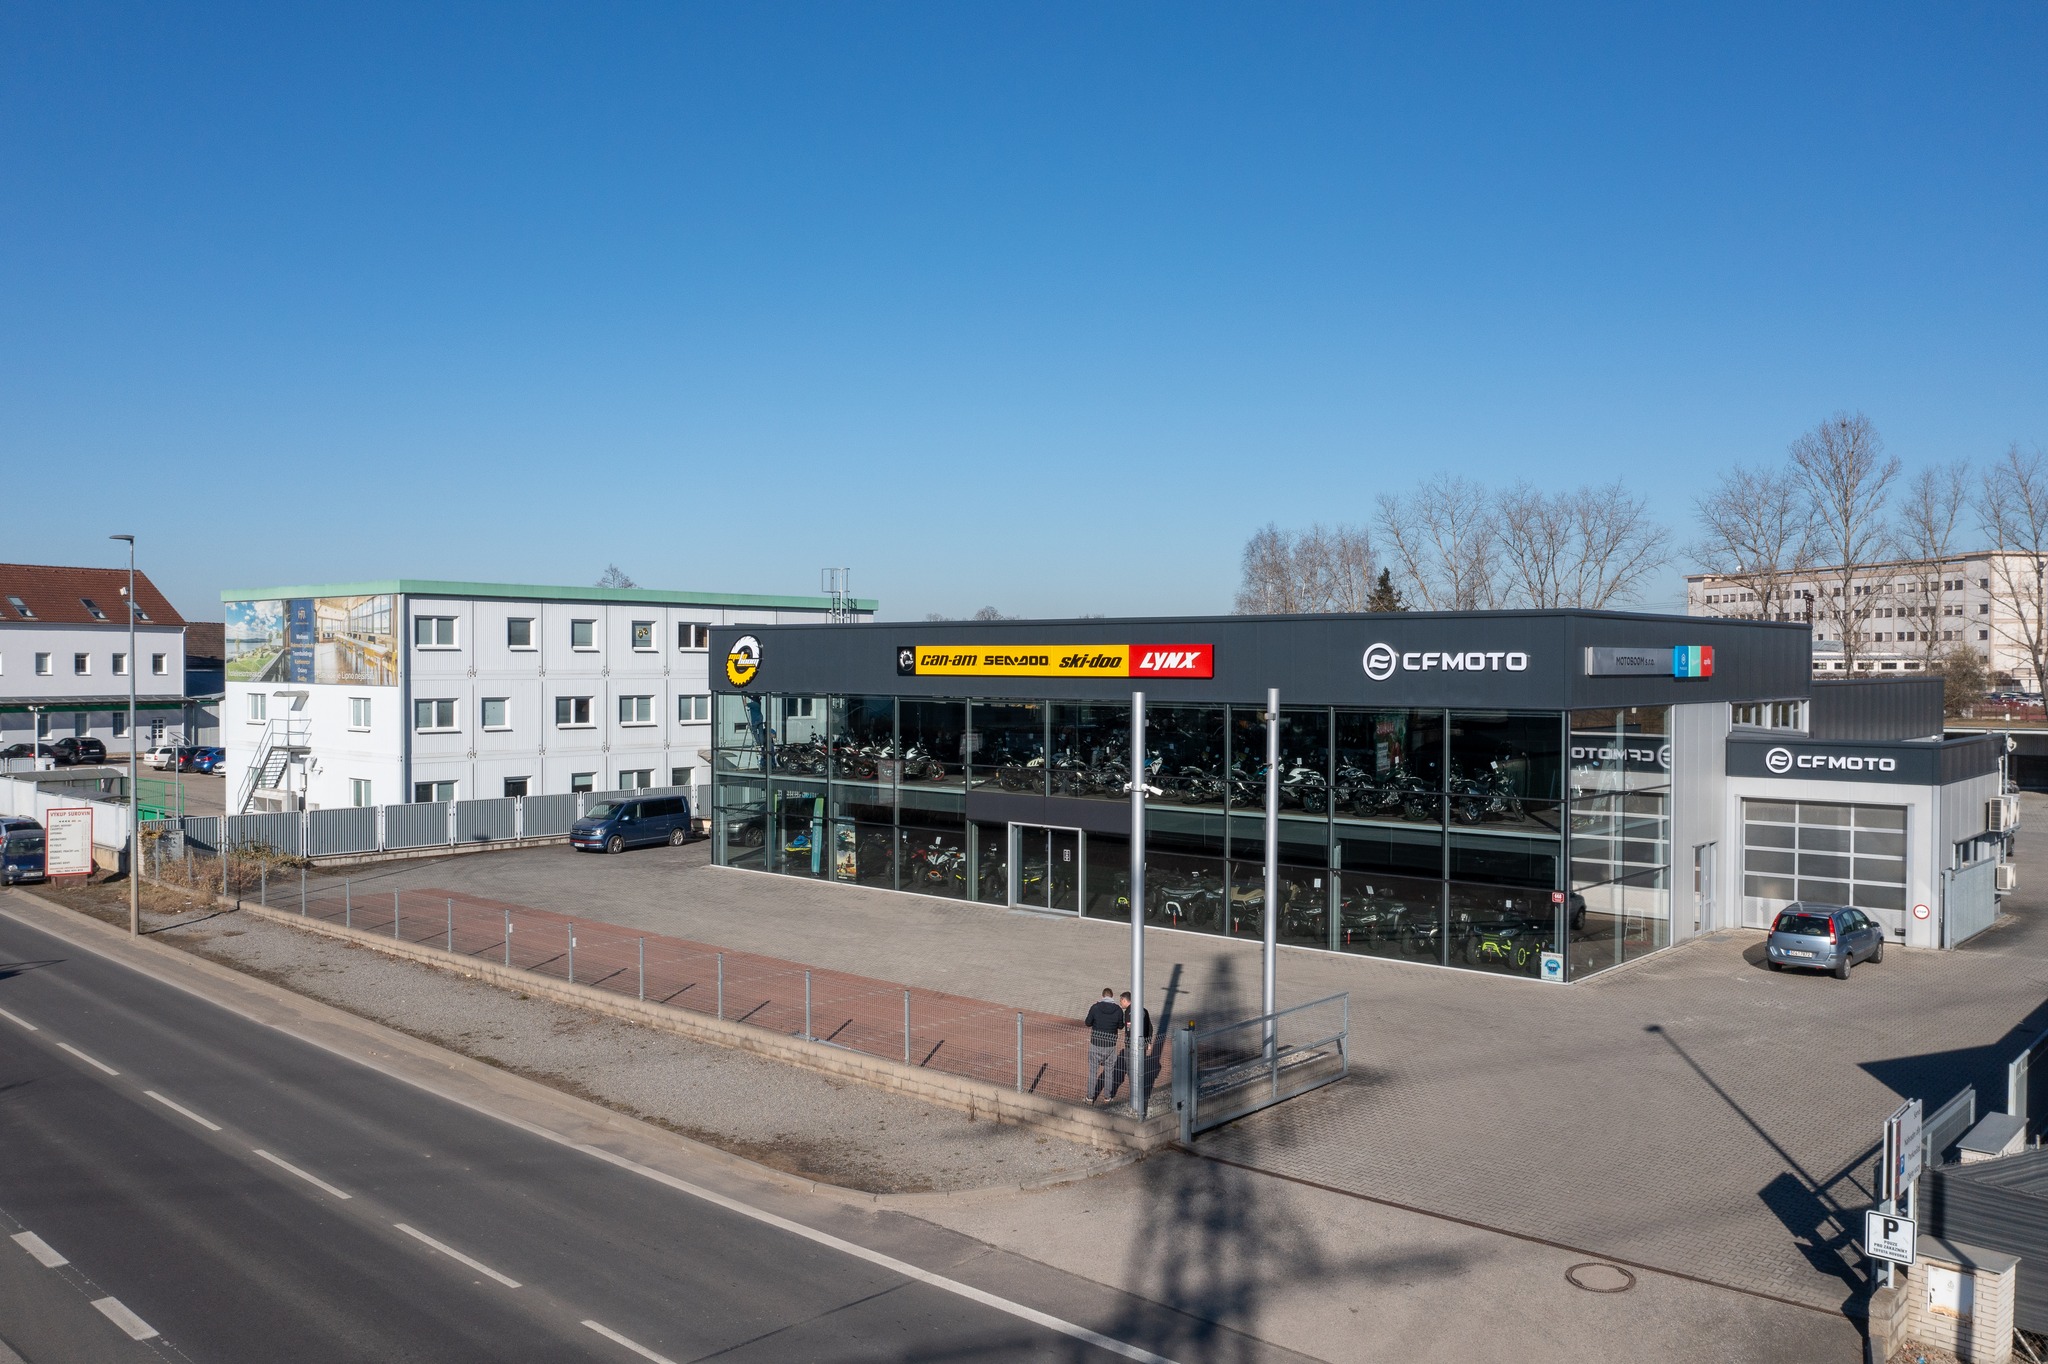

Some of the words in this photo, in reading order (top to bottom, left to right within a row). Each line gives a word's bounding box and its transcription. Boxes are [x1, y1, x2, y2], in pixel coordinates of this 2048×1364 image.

[1058, 653, 1123, 668] ski-doo
[1139, 652, 1201, 671] LYNX
[1403, 652, 1528, 671] CFMOTO
[1615, 656, 1645, 666] MOTOBOOM
[341, 671, 354, 680] Lipno
[1797, 755, 1896, 771] CFMOTO
[1883, 1218, 1899, 1240] P
